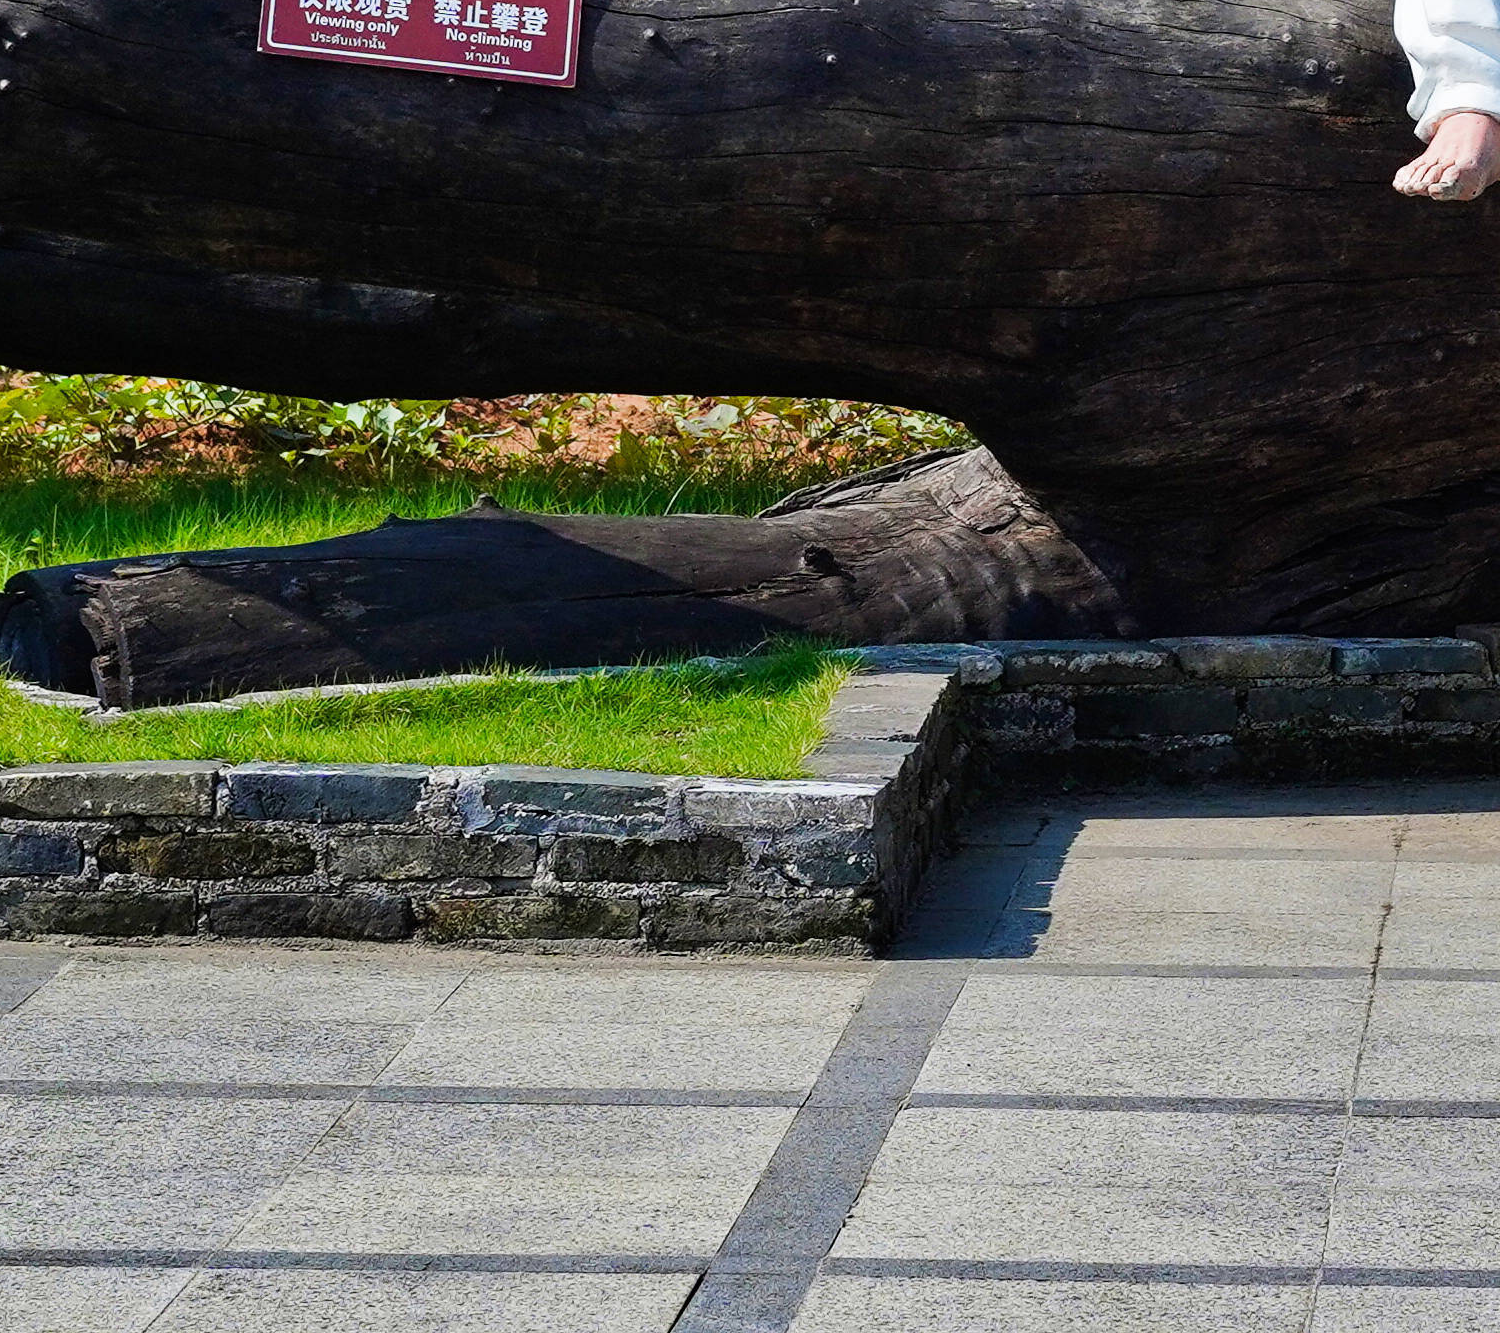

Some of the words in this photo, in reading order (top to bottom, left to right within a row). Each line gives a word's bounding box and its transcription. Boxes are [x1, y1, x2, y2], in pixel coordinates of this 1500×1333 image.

[305, 11, 364, 33] Viewing
[367, 21, 400, 37] only
[446, 28, 467, 42] No
[469, 31, 532, 52] climbing
